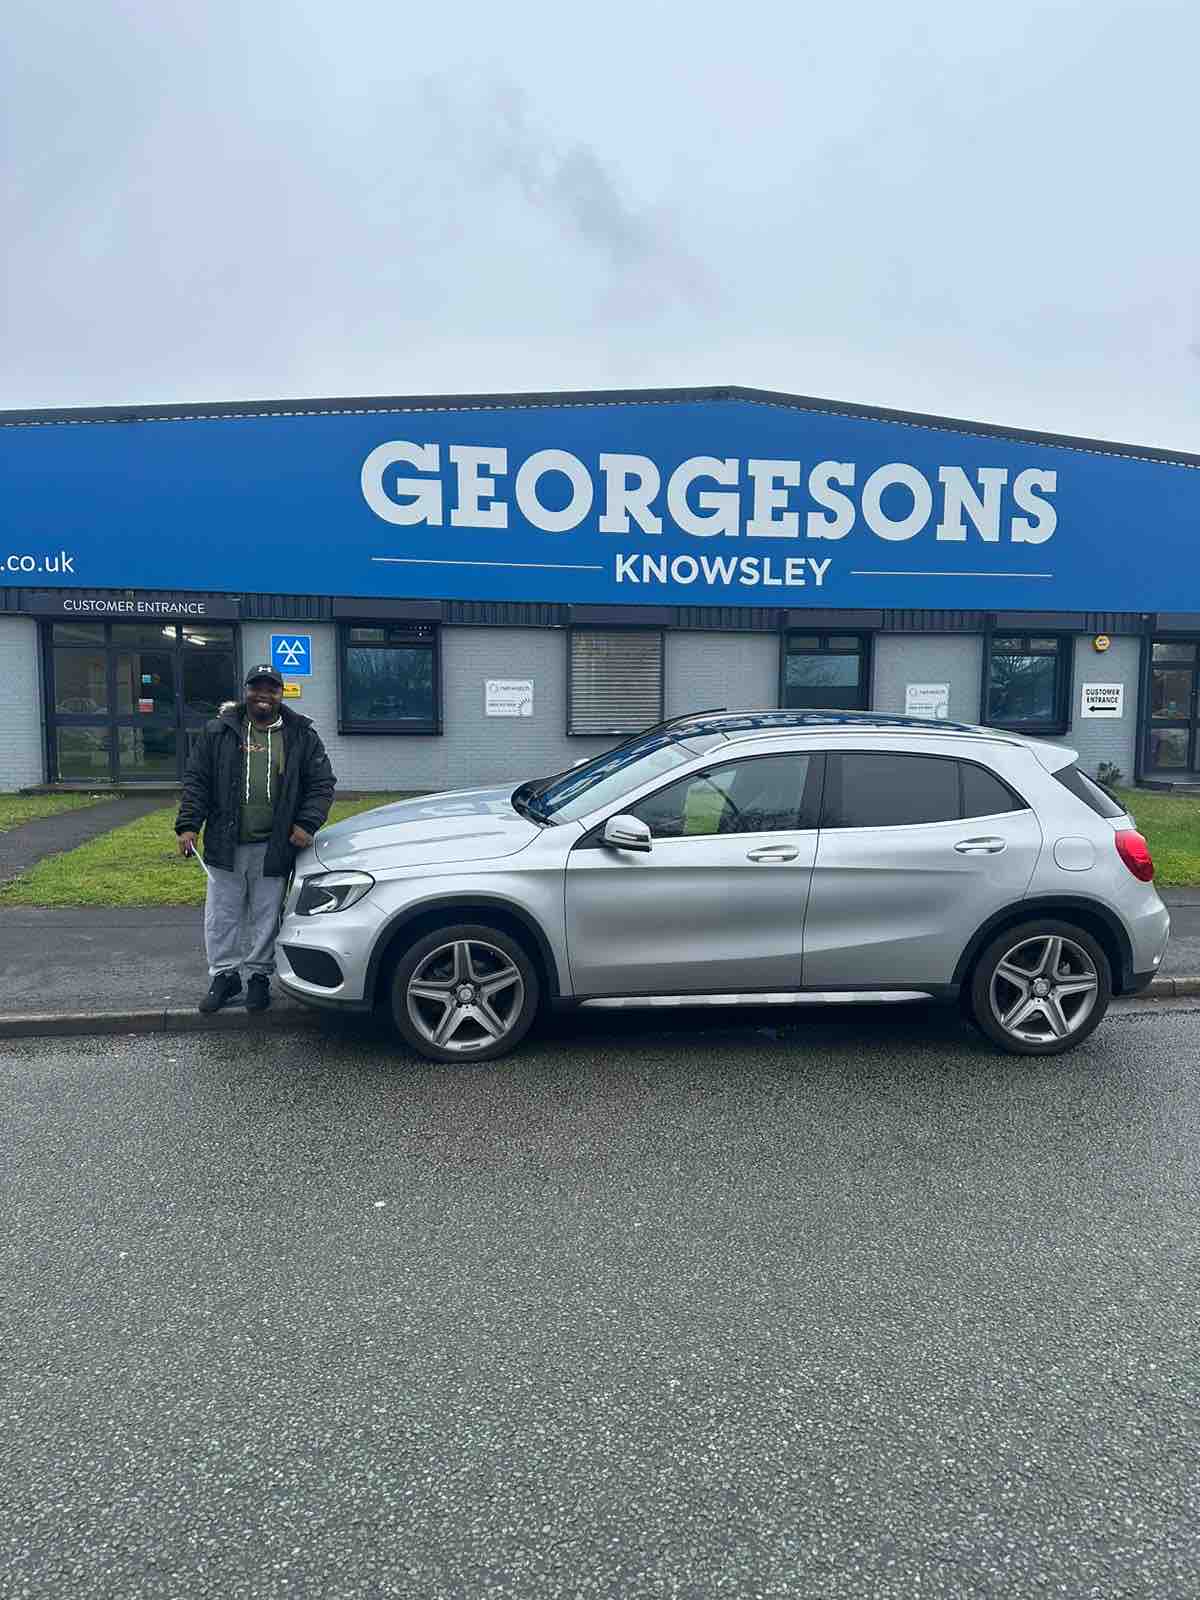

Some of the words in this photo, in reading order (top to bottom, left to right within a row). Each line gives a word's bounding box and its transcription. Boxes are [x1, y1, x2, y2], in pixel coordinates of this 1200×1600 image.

[361, 440, 1058, 545] GEORGESONS
[614, 553, 833, 587] KNOWSLEY
[63, 600, 134, 613] CUSTOMER
[137, 601, 206, 615] ENTRANCE
[1085, 688, 1120, 696] CUSTOMER
[1086, 696, 1119, 704] ENTRANCE
